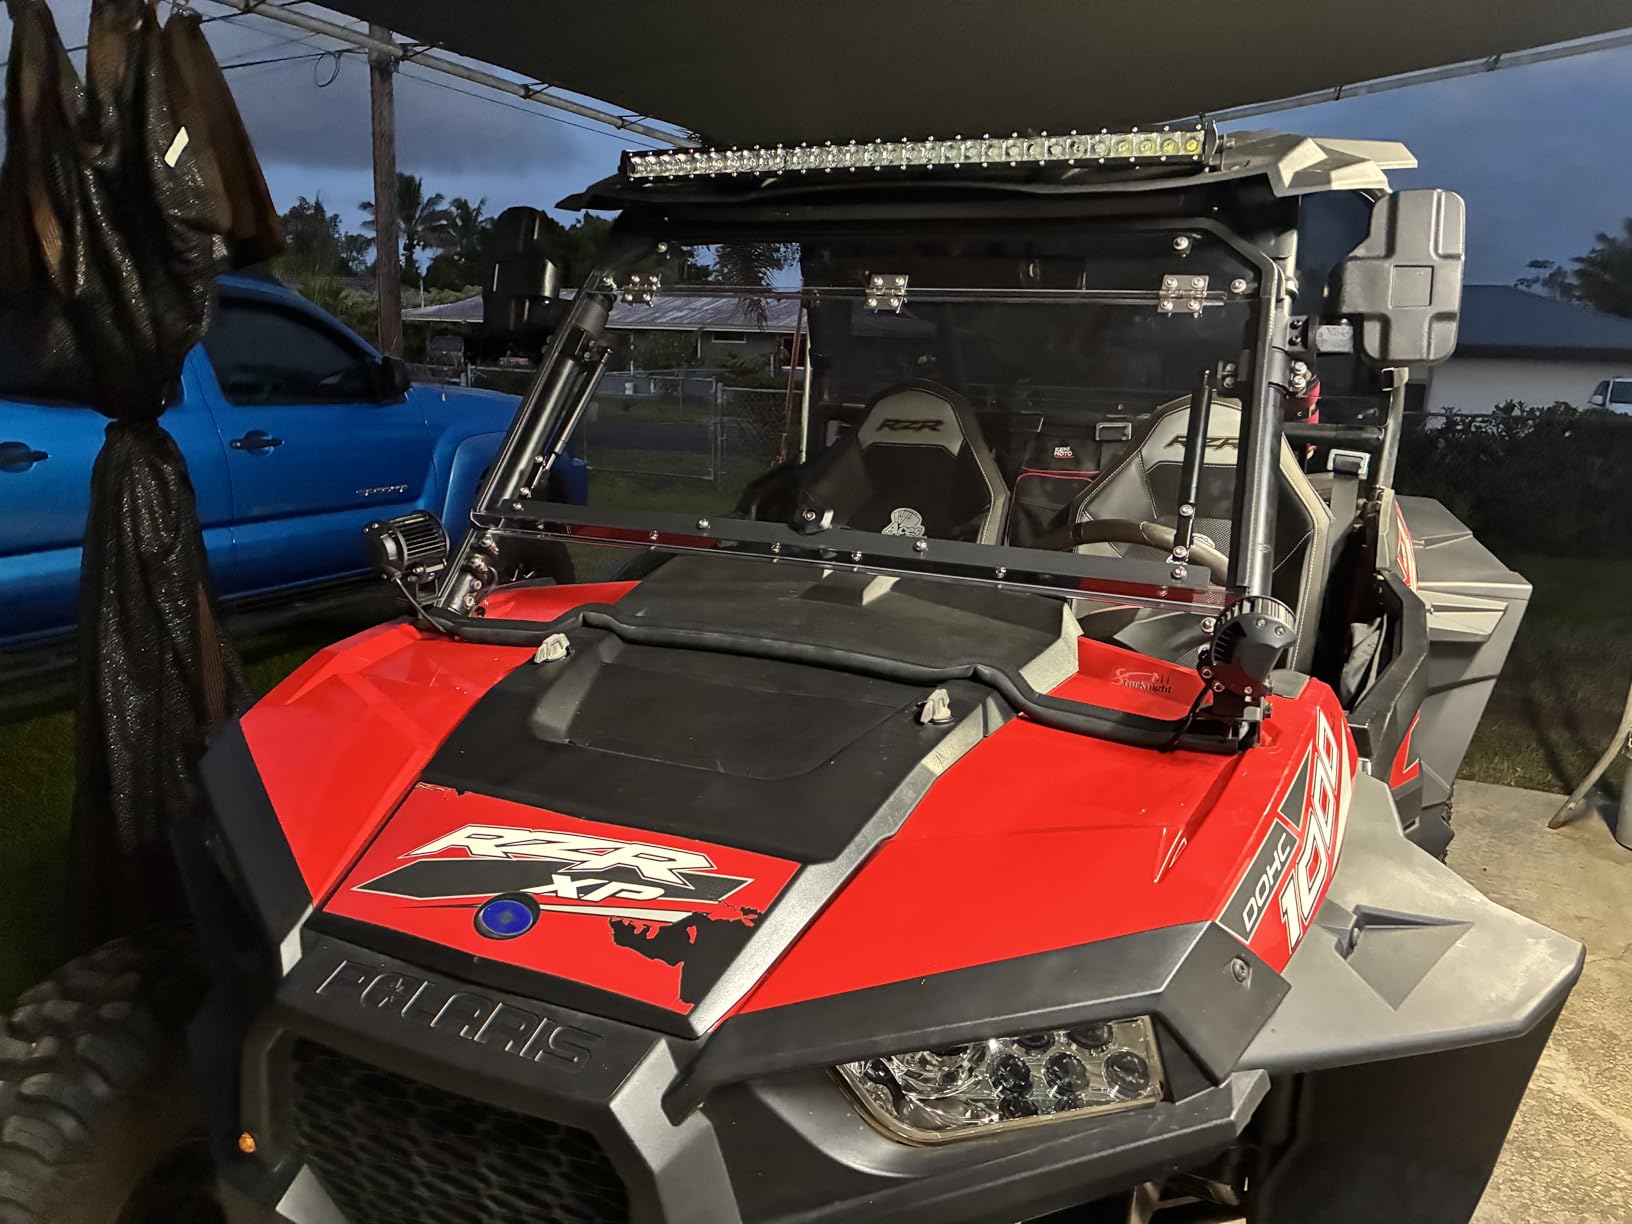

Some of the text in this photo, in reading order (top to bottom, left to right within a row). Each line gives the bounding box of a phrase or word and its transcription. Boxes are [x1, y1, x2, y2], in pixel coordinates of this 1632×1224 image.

[874, 418, 944, 432] RZR
[397, 824, 717, 889] RZR
[1279, 705, 1338, 954] 1000
[521, 874, 666, 902] XP
[1242, 832, 1291, 933] DOHC
[315, 960, 605, 1073] POLARIS
